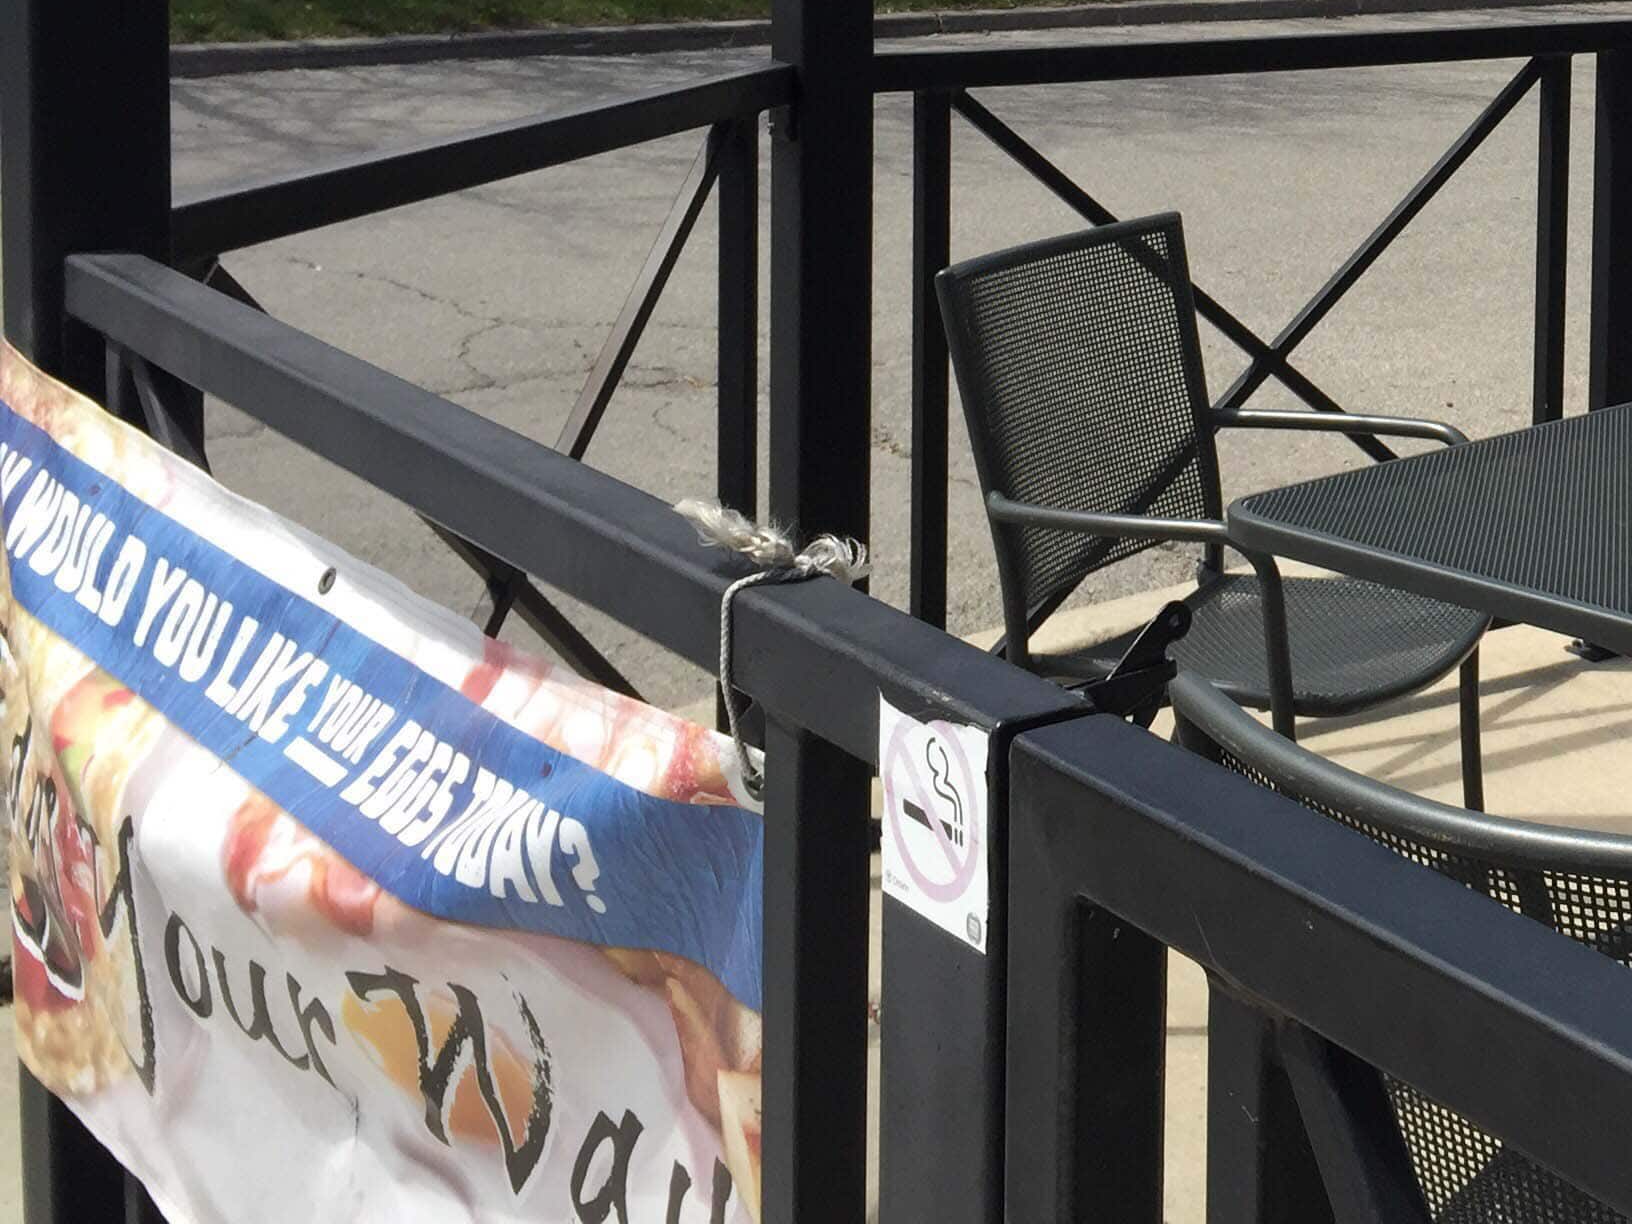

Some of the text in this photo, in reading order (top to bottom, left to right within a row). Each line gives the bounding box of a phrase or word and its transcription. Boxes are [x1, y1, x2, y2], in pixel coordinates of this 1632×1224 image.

[5, 468, 148, 627] WOULD
[133, 556, 234, 683] YOU
[204, 615, 330, 745] LIKE
[306, 673, 396, 766] YOUR
[338, 719, 471, 848] EGGS
[420, 766, 607, 915] TODAY?
